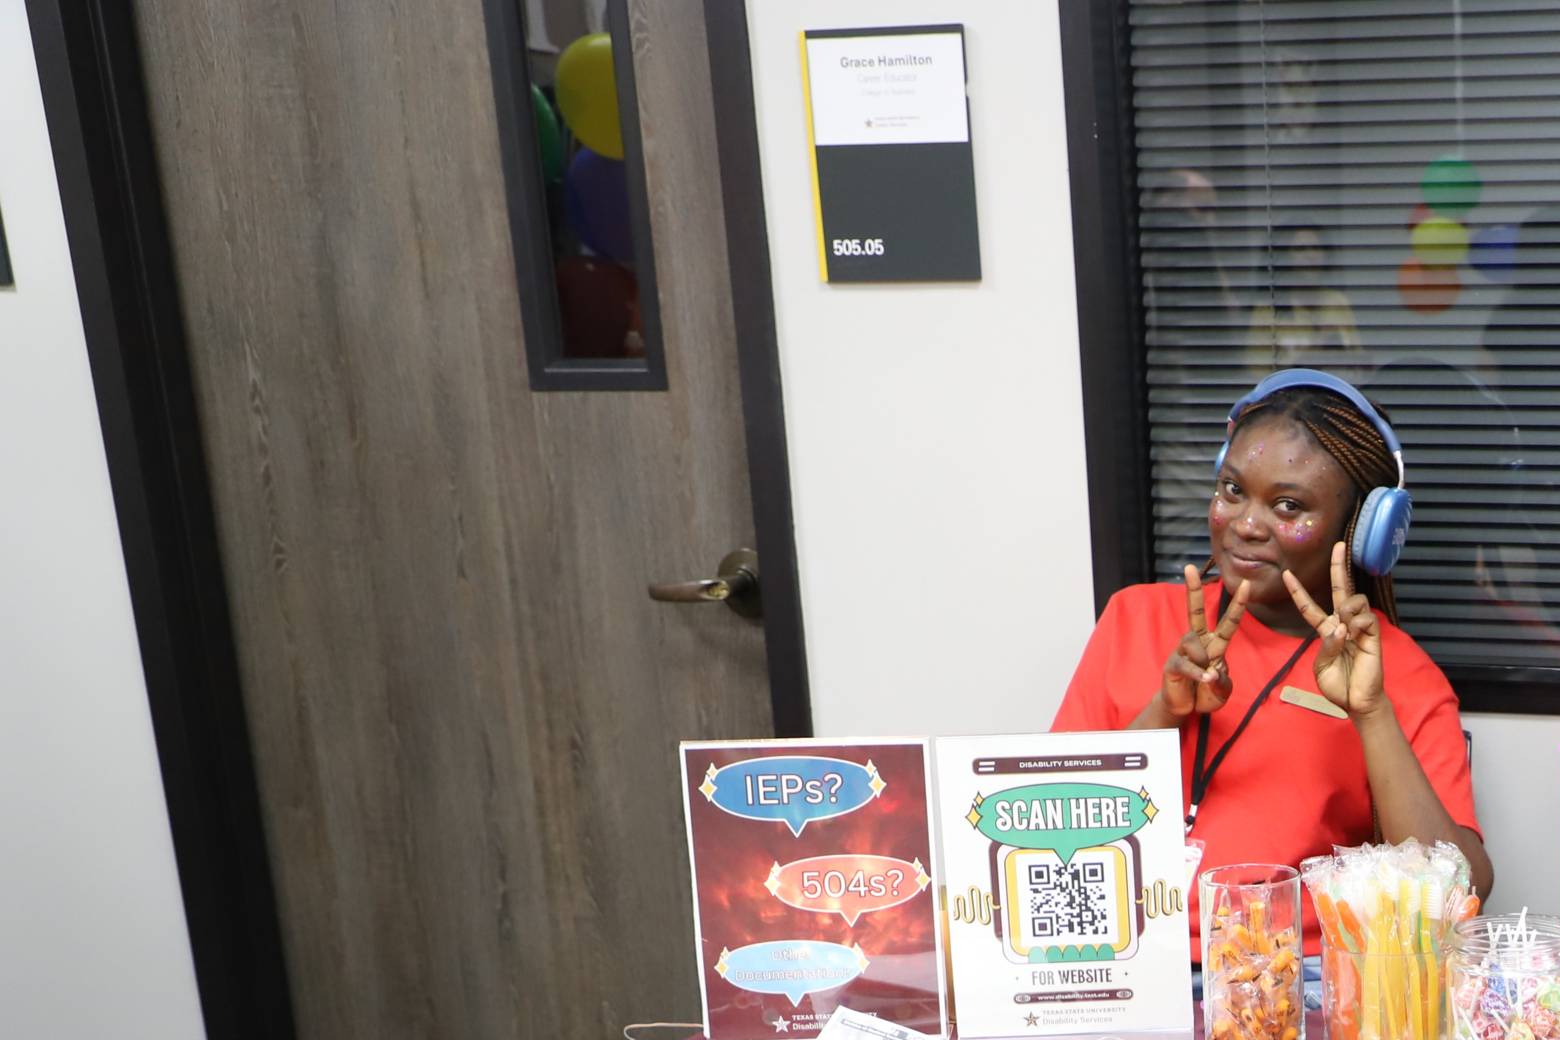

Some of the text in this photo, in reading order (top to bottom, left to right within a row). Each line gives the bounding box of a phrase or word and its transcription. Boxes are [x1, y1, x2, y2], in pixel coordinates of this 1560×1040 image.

[840, 54, 933, 69] Grace Hamilton
[833, 239, 884, 256] 505.05
[1019, 759, 1102, 769] DISABILITY SERVICES
[744, 772, 844, 806] IEPs?
[995, 796, 1132, 832] SCAN HERE
[801, 869, 904, 899] 504s?
[1032, 968, 1113, 986] FOR WEBSITE
